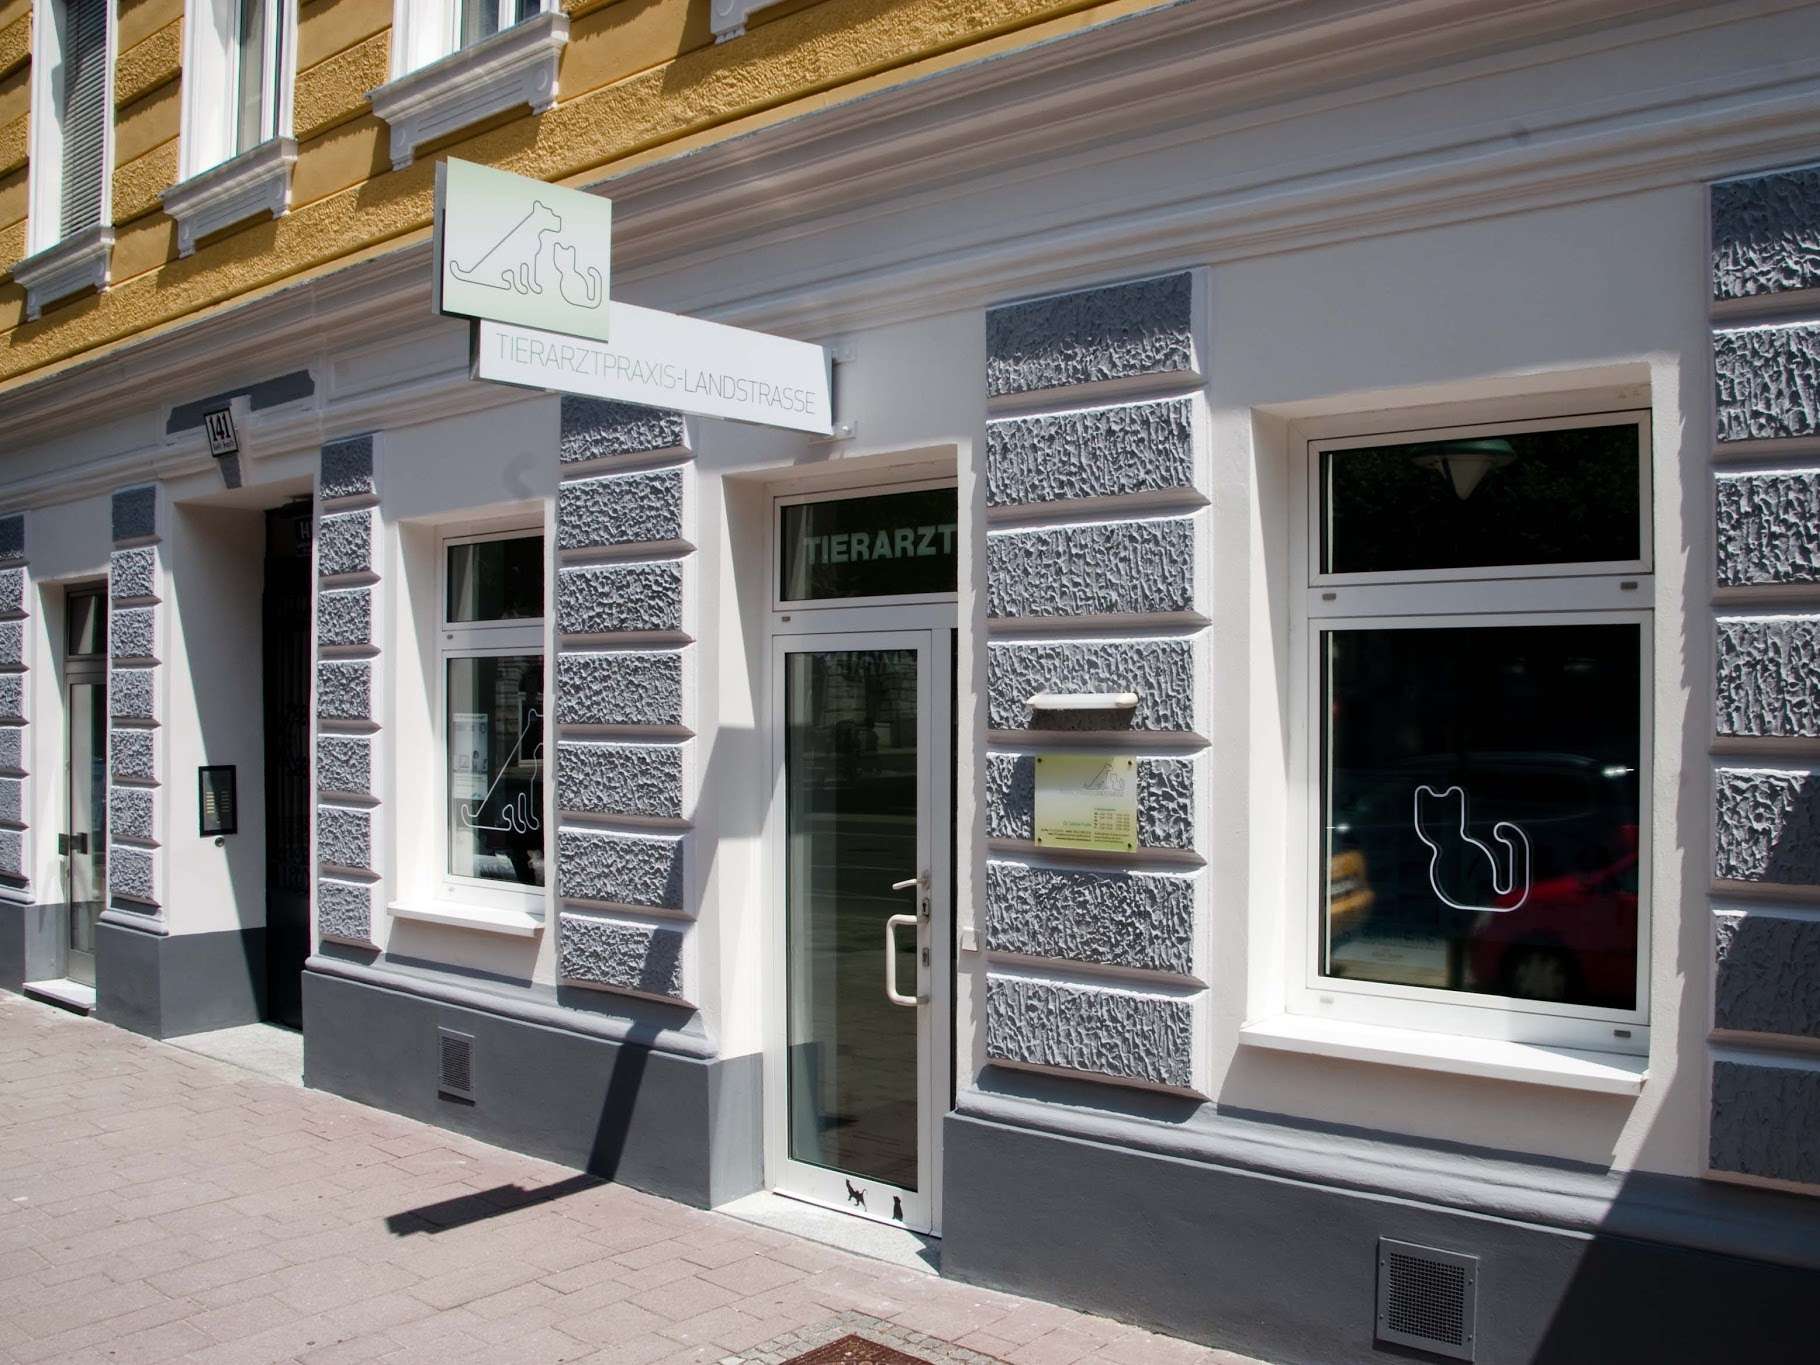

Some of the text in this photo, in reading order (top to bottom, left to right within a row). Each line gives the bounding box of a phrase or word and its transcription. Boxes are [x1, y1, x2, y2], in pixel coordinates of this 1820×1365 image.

[496, 332, 816, 415] TIERARZTPRAXIS-LANDSTRASSE
[209, 412, 231, 441] 141
[804, 523, 957, 565] TIERARZT
